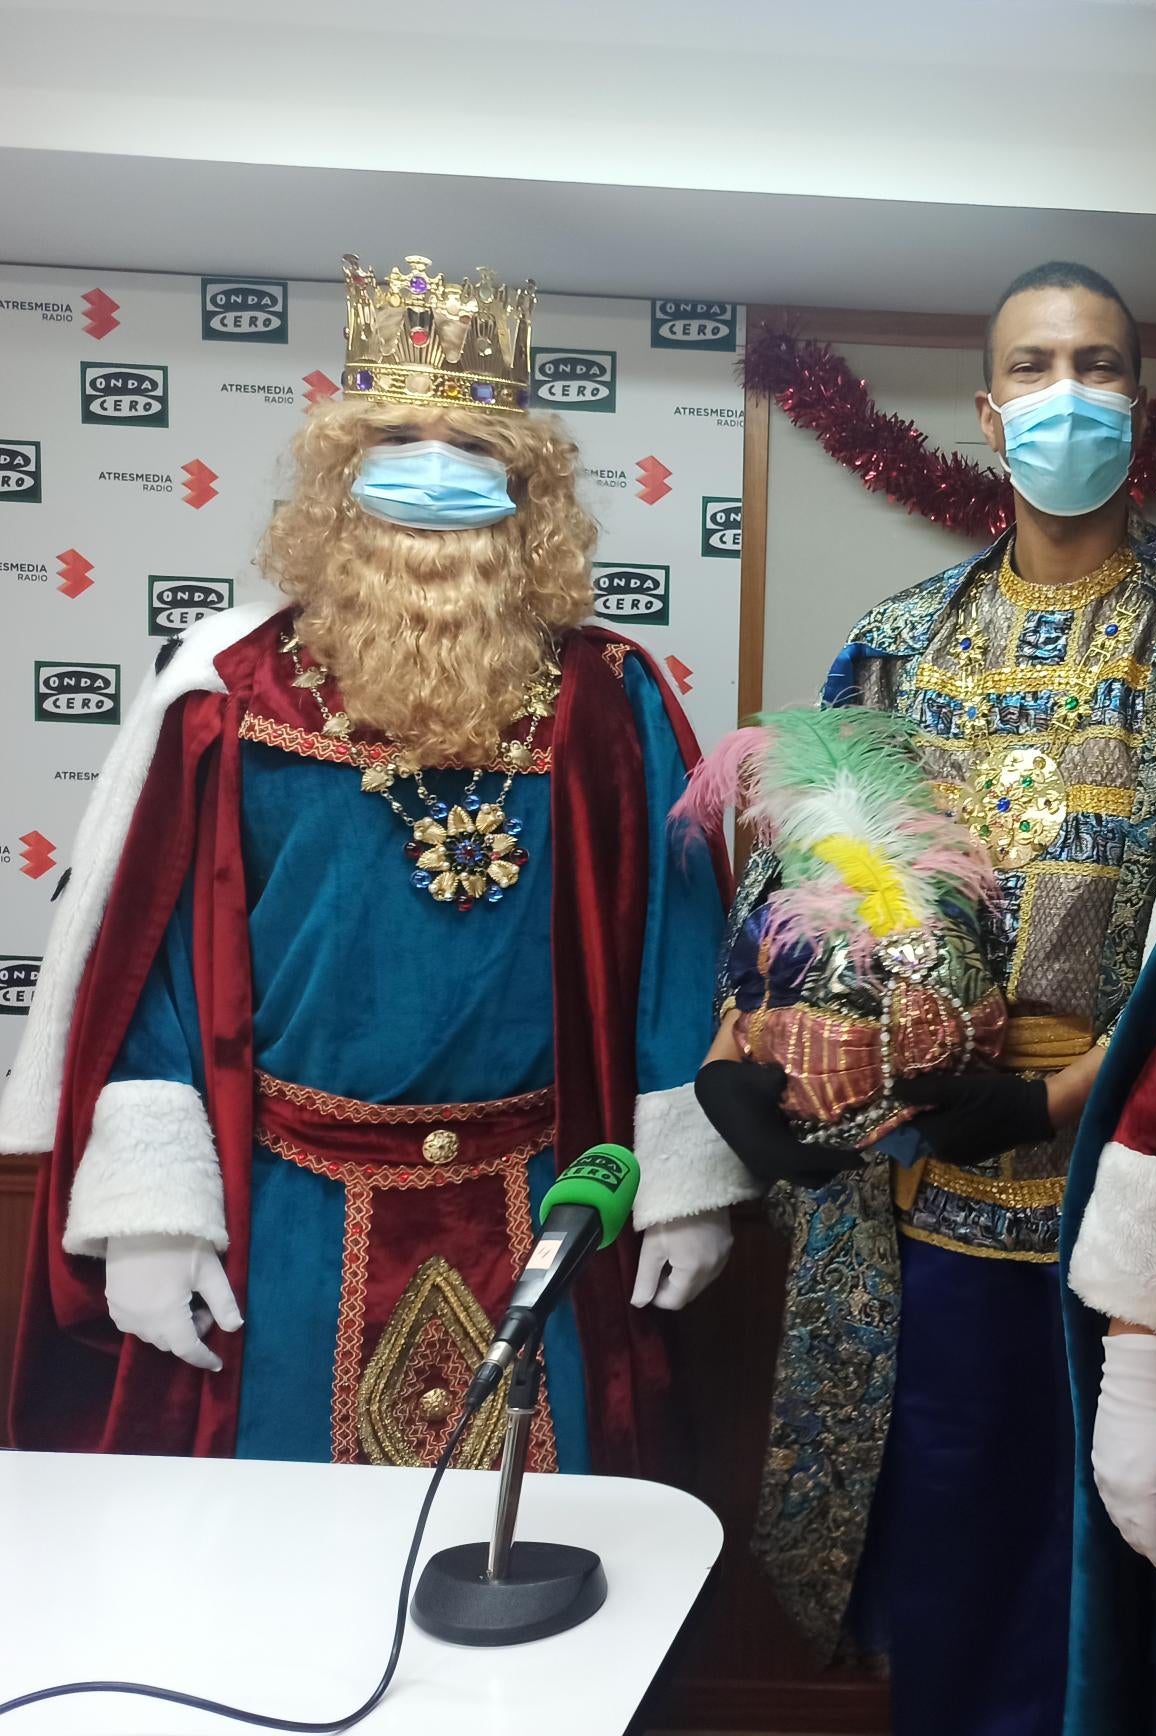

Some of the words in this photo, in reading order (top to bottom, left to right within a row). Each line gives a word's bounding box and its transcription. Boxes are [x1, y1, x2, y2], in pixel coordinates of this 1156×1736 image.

[216, 294, 272, 306] ONDA
[665, 302, 721, 315] ONDA
[42, 313, 73, 322] RADIO
[219, 315, 272, 329] CERO
[667, 323, 721, 337] CERO
[545, 362, 601, 375] ONDA
[96, 378, 152, 390] ONDA
[220, 383, 294, 395] ATRESMEDIA
[549, 383, 600, 398] CERO
[100, 399, 153, 413] CERO
[264, 395, 294, 405] RADIO
[674, 406, 745, 418] ATRESMEDIA
[0, 455, 25, 465] DA
[1, 475, 25, 488] RO
[98, 471, 173, 483] ATRESMEDIA
[142, 484, 173, 493] RADIO
[716, 512, 741, 523] ON
[719, 533, 741, 545] CE
[0, 562, 47, 573] ESMEDIA
[17, 573, 48, 582] RADIO
[600, 577, 655, 590] ONDA
[162, 591, 218, 602] ONDA
[603, 598, 654, 612] CERO
[166, 611, 204, 623] CER
[50, 677, 105, 688] ONDA
[52, 697, 105, 710] CERO
[54, 771, 100, 781] ATRESM
[0, 970, 39, 980] OND
[2, 990, 34, 1003] CE
